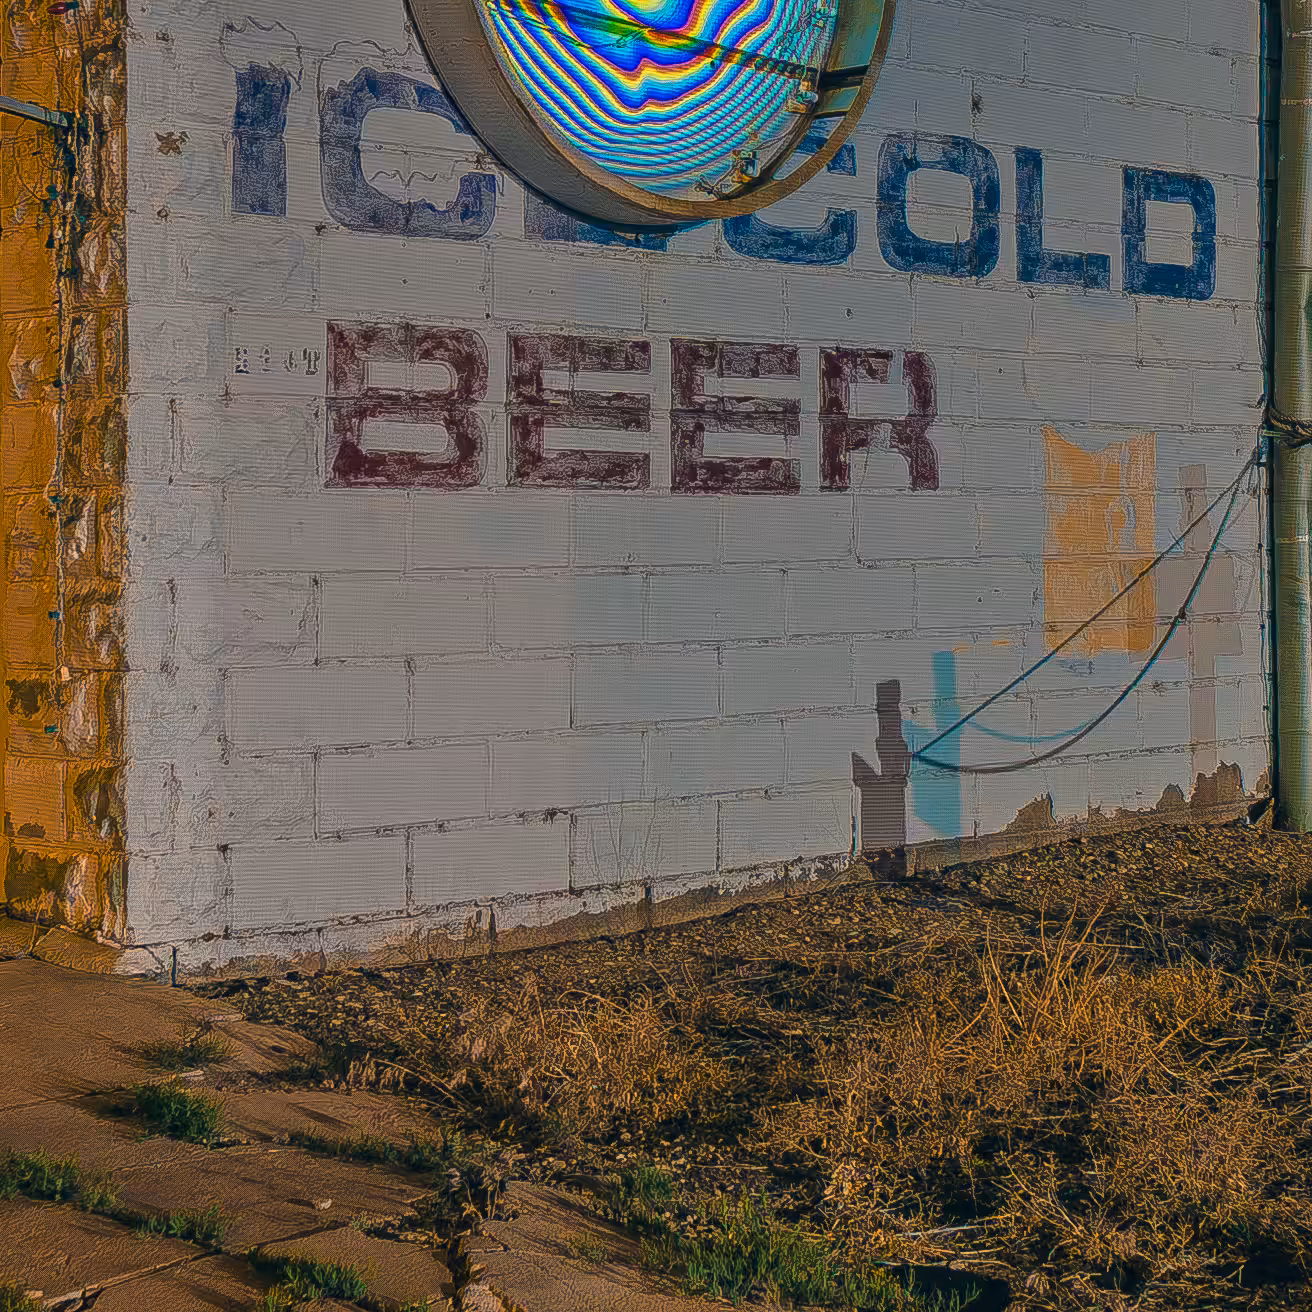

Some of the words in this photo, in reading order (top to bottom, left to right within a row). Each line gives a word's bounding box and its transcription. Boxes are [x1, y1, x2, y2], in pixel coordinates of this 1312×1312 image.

[232, 64, 668, 252] IC
[722, 119, 1217, 301] COLD
[325, 319, 939, 494] BEER
